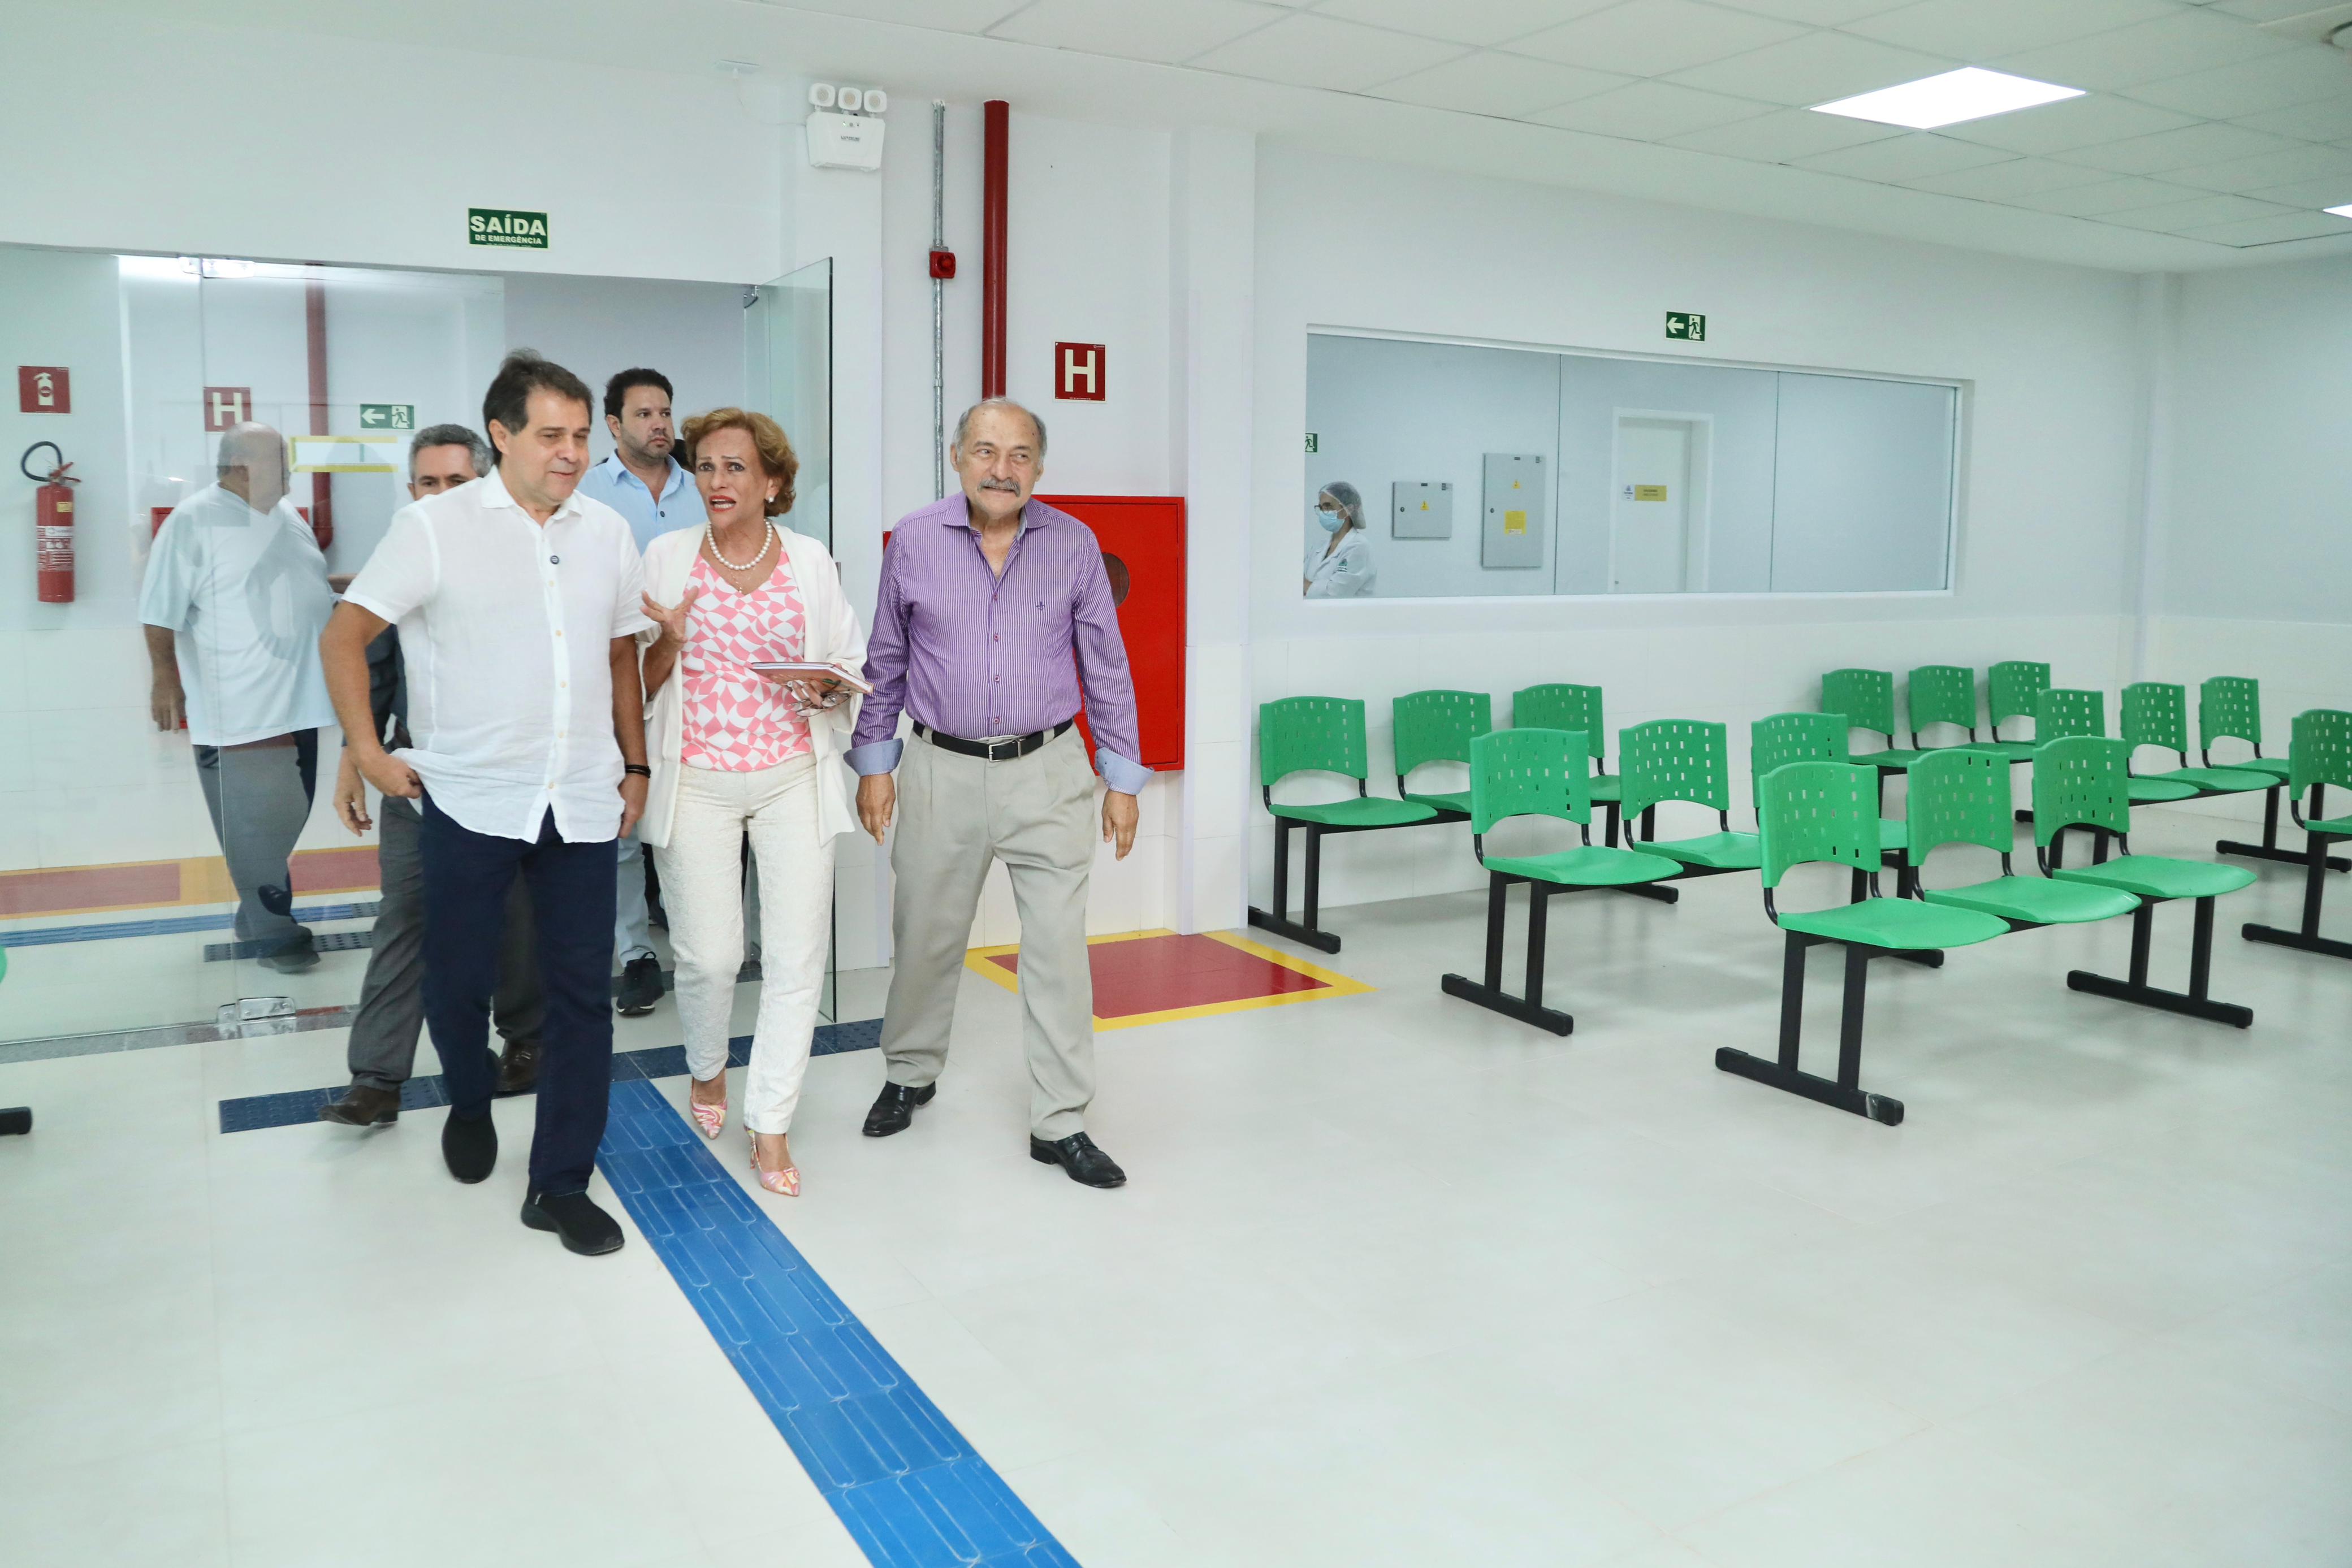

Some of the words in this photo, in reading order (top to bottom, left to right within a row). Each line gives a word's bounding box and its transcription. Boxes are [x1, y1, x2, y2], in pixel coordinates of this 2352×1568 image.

[470, 214, 547, 236] SAÍDA
[488, 235, 542, 245] EMERGÊNCIA
[1065, 349, 1096, 393] H
[213, 392, 243, 426] H
